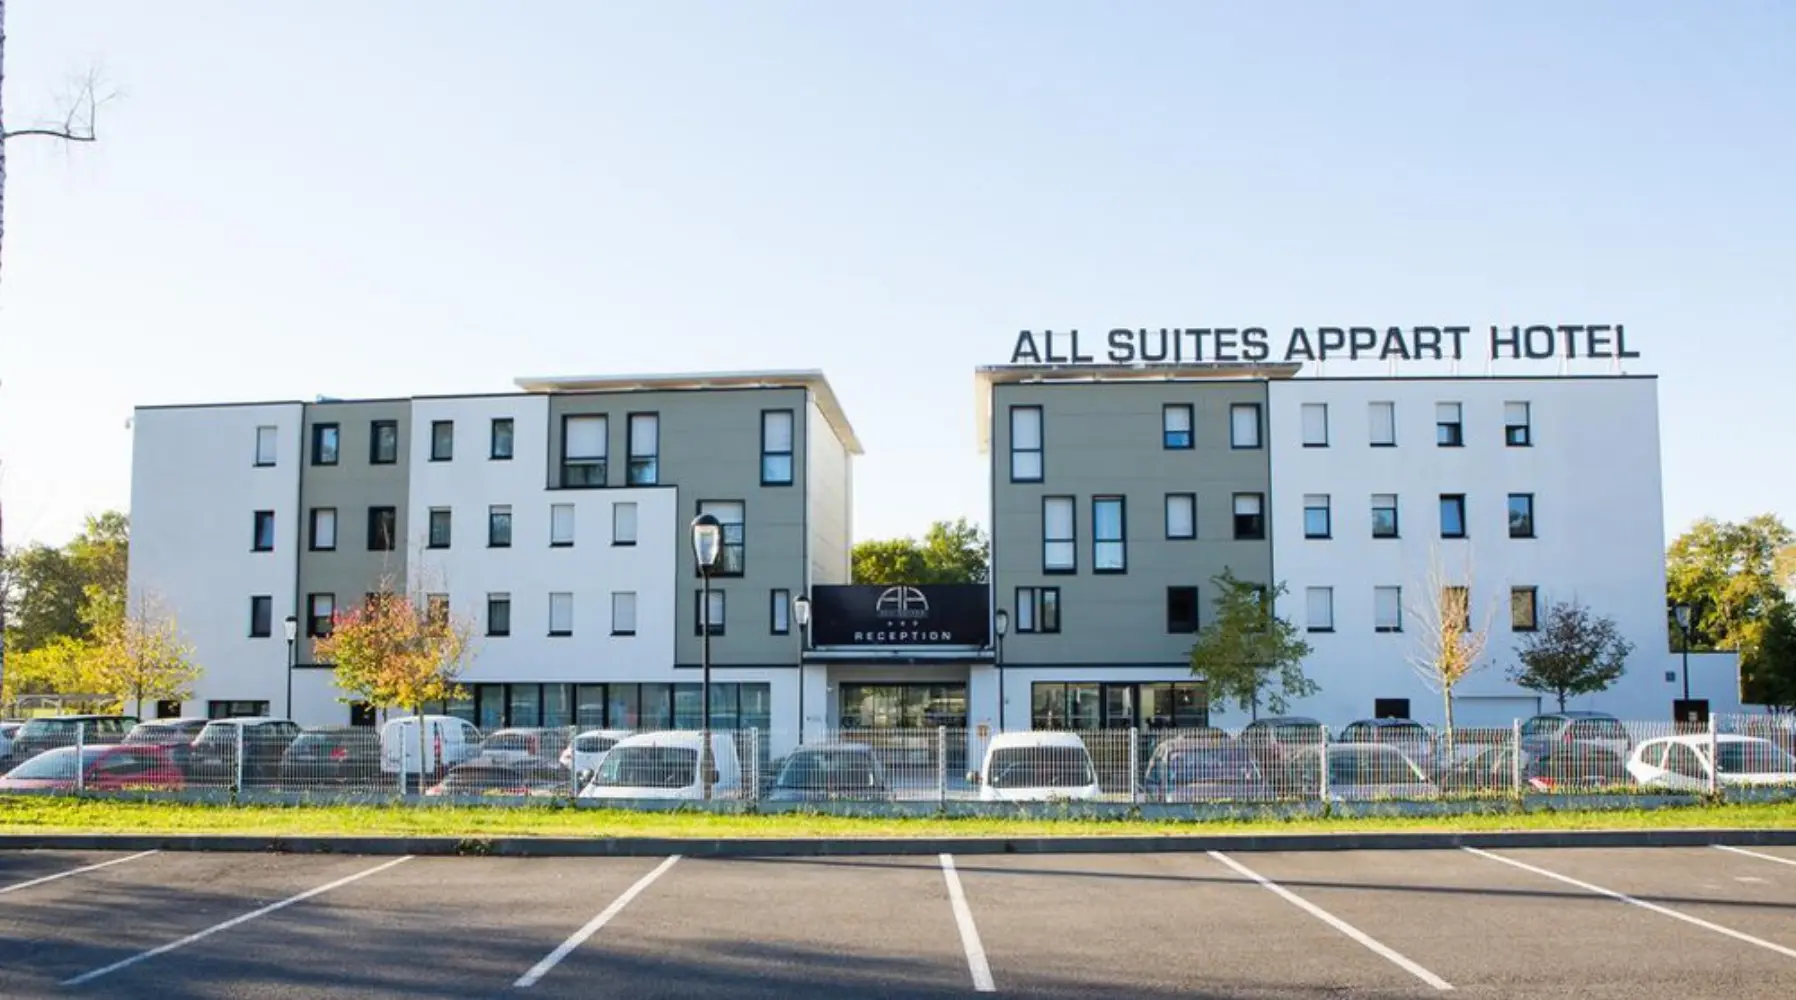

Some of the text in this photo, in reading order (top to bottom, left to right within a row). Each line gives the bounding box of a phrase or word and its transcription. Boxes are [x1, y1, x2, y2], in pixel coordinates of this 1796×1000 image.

[1010, 324, 1640, 363] ALL SUITES APPART HOTEL
[854, 631, 952, 641] RECEPTION
